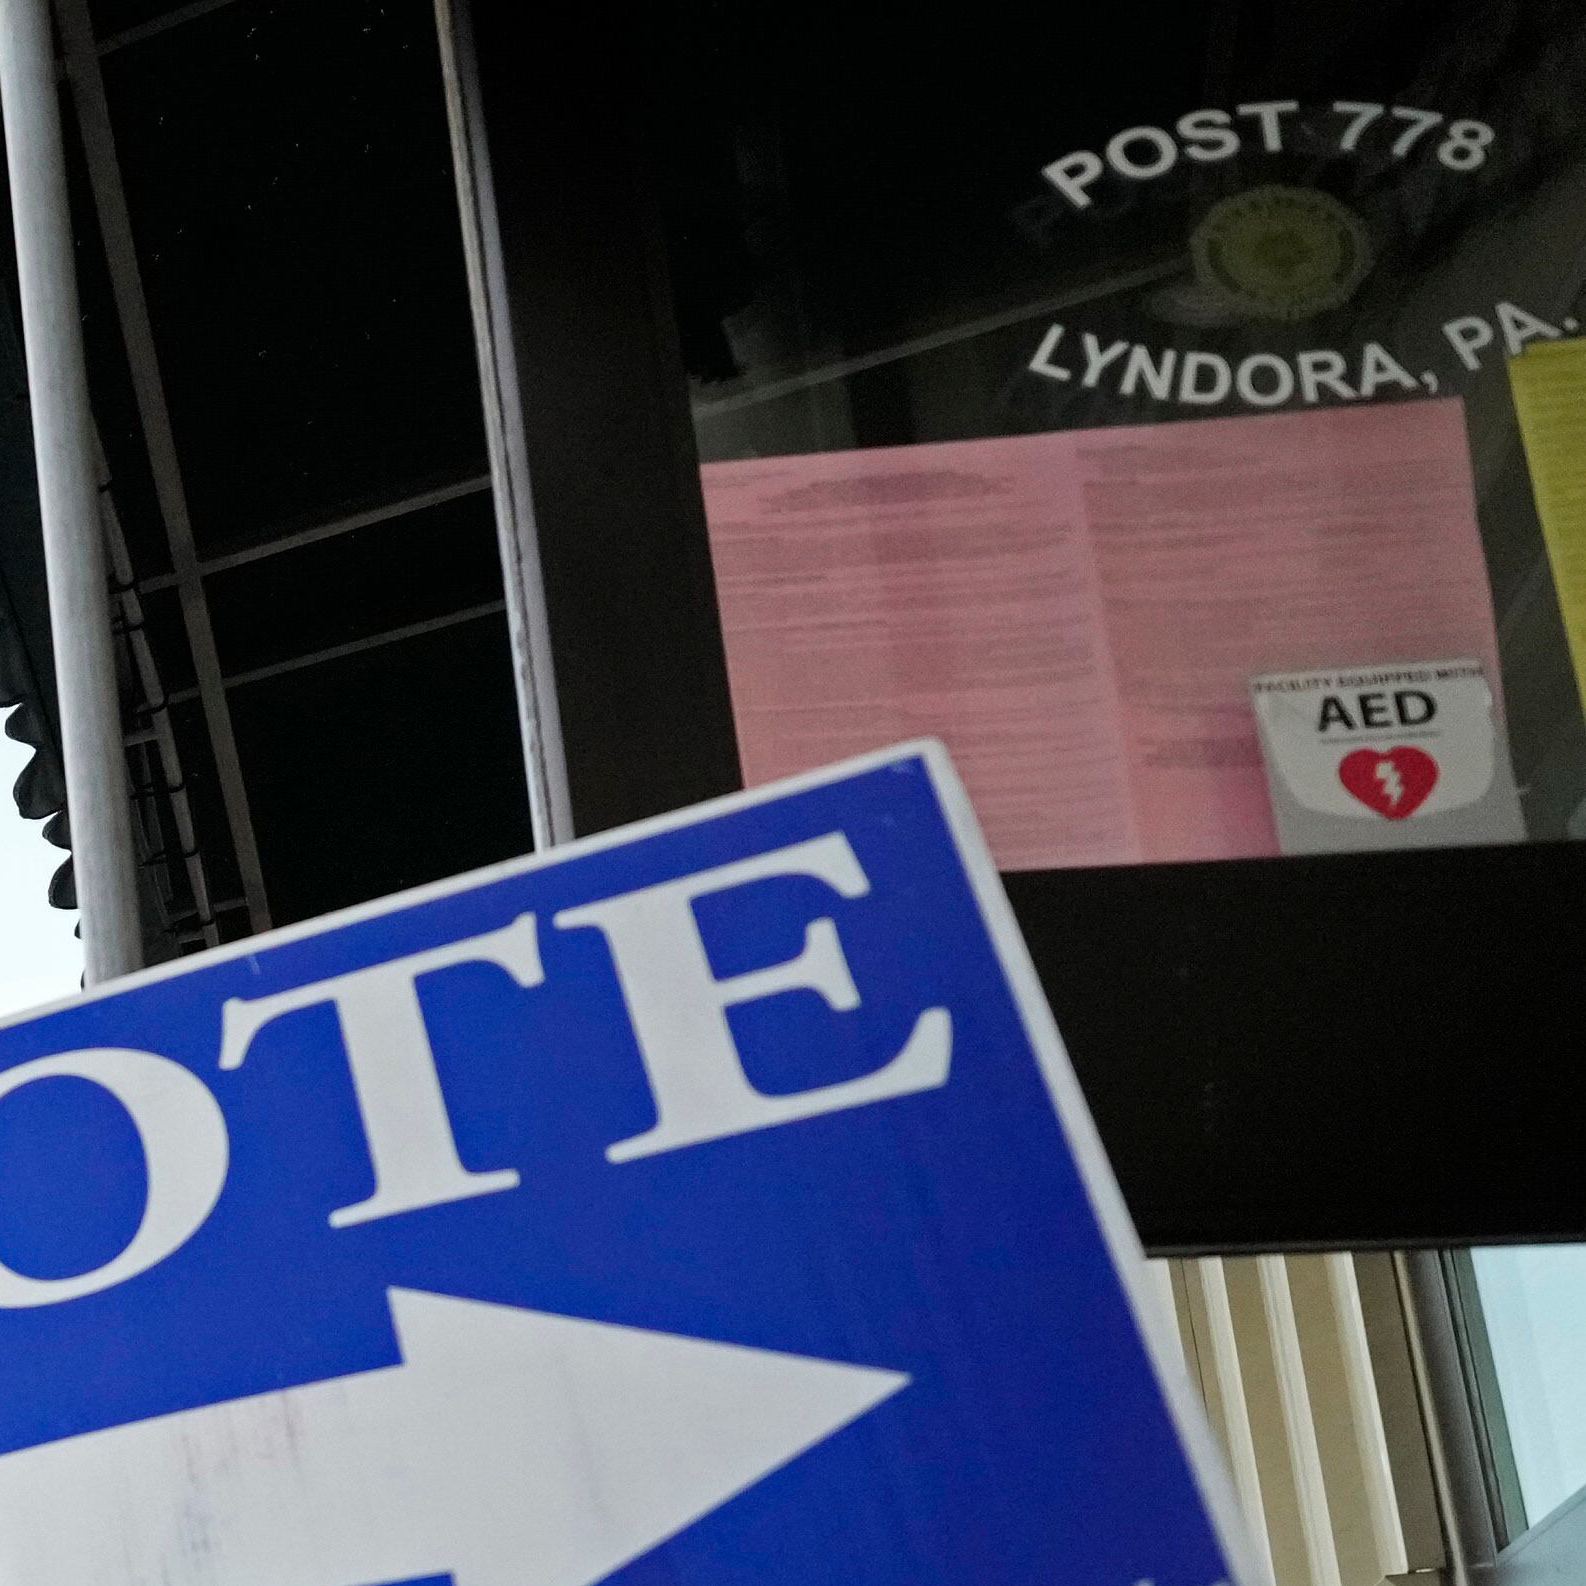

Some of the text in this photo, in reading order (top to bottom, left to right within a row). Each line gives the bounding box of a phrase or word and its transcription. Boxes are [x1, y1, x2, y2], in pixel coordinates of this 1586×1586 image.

[1041, 100, 1496, 209] POST 778
[1028, 301, 1578, 403] LYNDORA, PA.
[1254, 676, 1332, 694] FACILITY
[1335, 669, 1433, 688] EQUIPPED
[1317, 689, 1438, 733] AED
